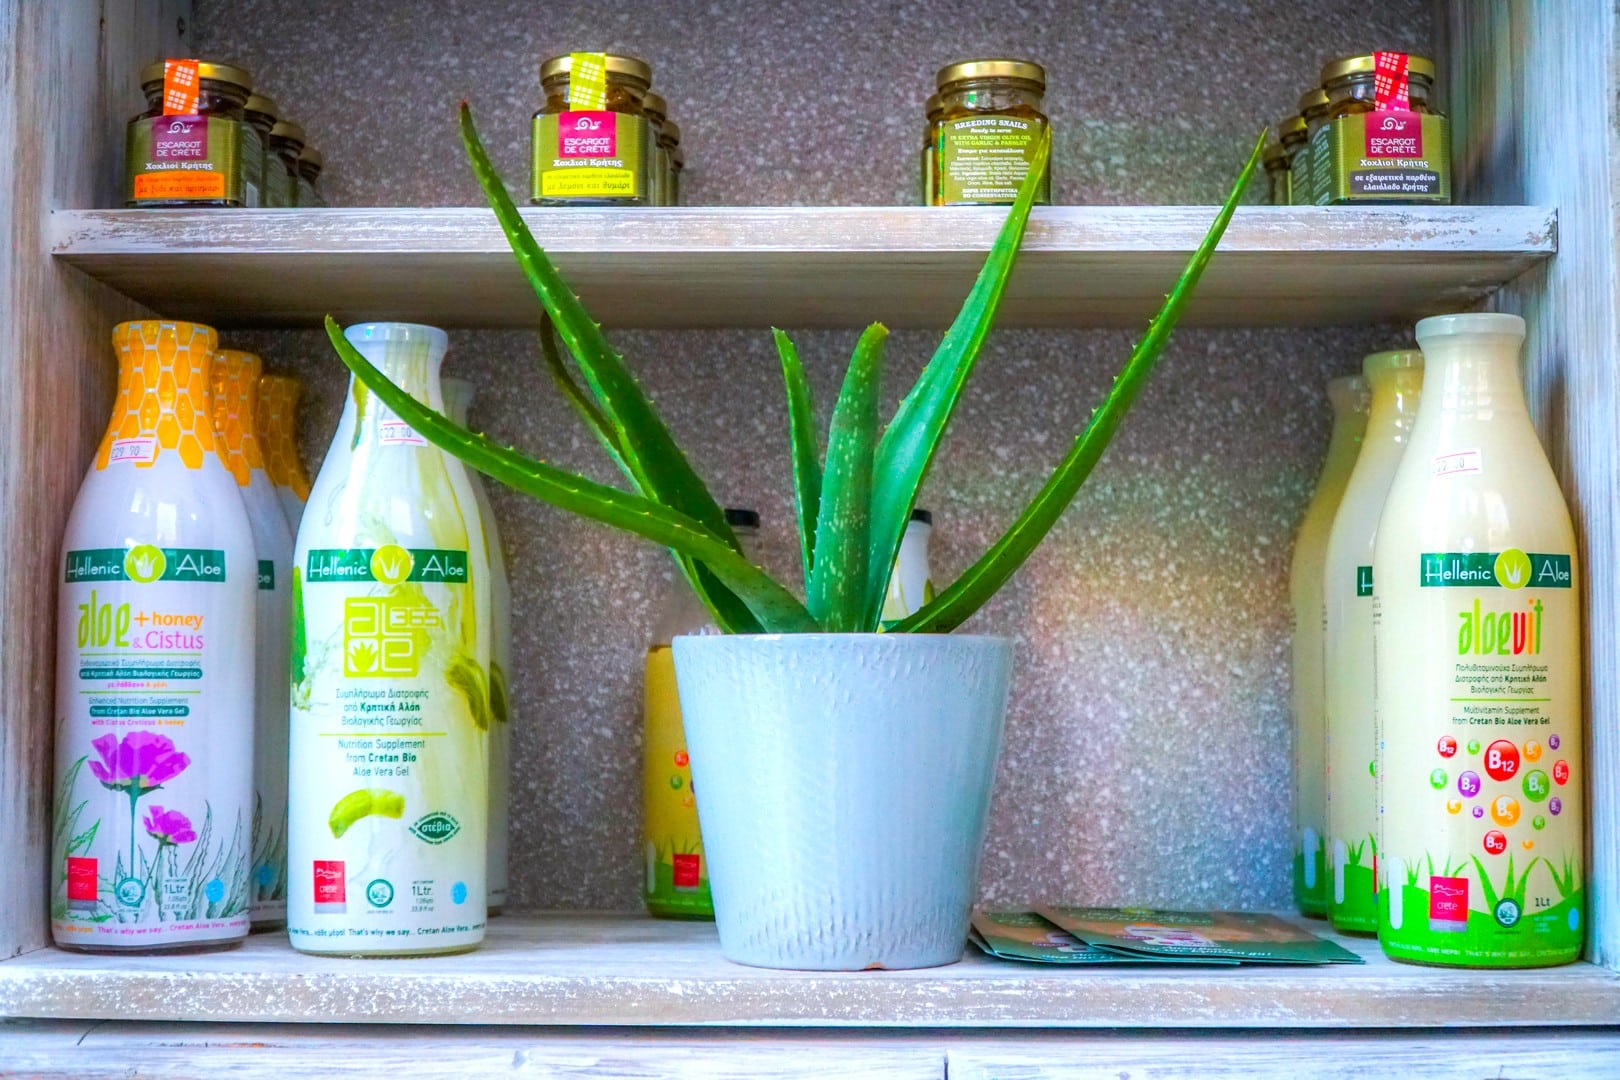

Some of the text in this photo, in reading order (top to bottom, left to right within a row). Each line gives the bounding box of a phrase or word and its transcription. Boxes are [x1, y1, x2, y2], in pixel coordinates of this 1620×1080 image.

[954, 119, 1028, 130] BREEDING SNAILS
[157, 141, 201, 149] ESCARGOT
[1371, 138, 1416, 146] ESCARGOT
[157, 149, 168, 157] DE
[181, 162, 213, 170] Κρήτης
[590, 159, 623, 168] Κρήτης
[1397, 159, 1429, 168] Κρήτης
[1405, 174, 1436, 182] παρθένο
[1363, 183, 1429, 192] ελαιόλαδο Κρήτης
[67, 553, 221, 579] Hellenic Aloe
[309, 555, 464, 578] Hellenic Aloe
[1425, 559, 1569, 583] Hellenic Aloe
[78, 589, 130, 649] aloe
[1458, 597, 1543, 656] aloevit
[145, 630, 204, 650] Cistus
[360, 702, 395, 714] Κρητική
[398, 702, 421, 712] Αλόη
[1463, 706, 1540, 714] Multivitamin Supplement
[1452, 717, 1550, 725] from Cretan Bio Aloe Vera Gel
[338, 739, 425, 751] Nutrition Supplement
[1439, 741, 1454, 754] B12
[346, 752, 417, 762] from Cretan Bio
[1488, 749, 1514, 772] B12
[353, 767, 410, 776] Aloe Vera Gel
[1461, 777, 1476, 793] B2
[421, 821, 451, 834] στέβια
[1486, 836, 1503, 850] B12
[348, 928, 368, 936] That's
[371, 930, 384, 938] why
[417, 927, 440, 935] Cretan
